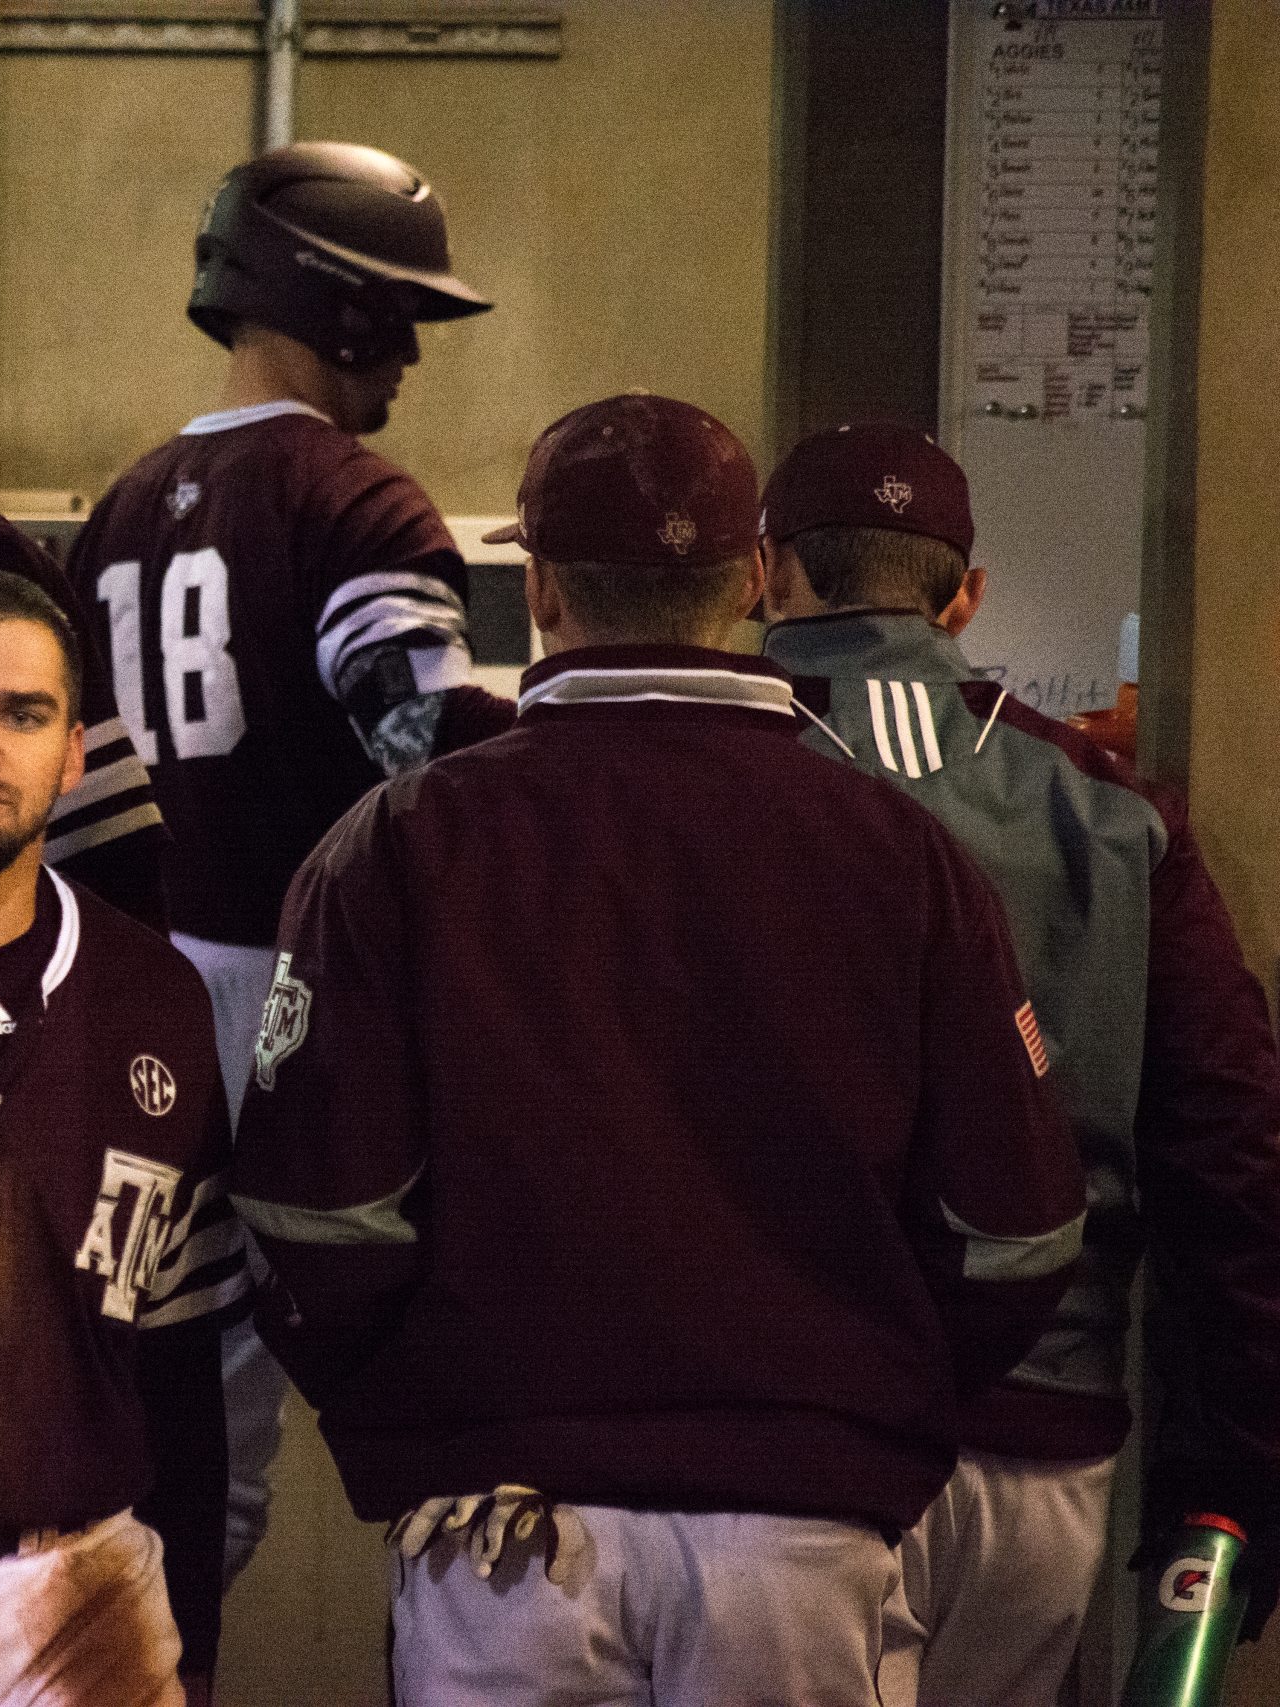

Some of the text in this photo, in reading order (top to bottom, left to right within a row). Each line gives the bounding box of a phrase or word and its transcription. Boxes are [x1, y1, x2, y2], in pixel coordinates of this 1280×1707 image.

[992, 44, 1065, 60] AGGIES
[97, 547, 249, 767] 18
[131, 1057, 176, 1115] SEC
